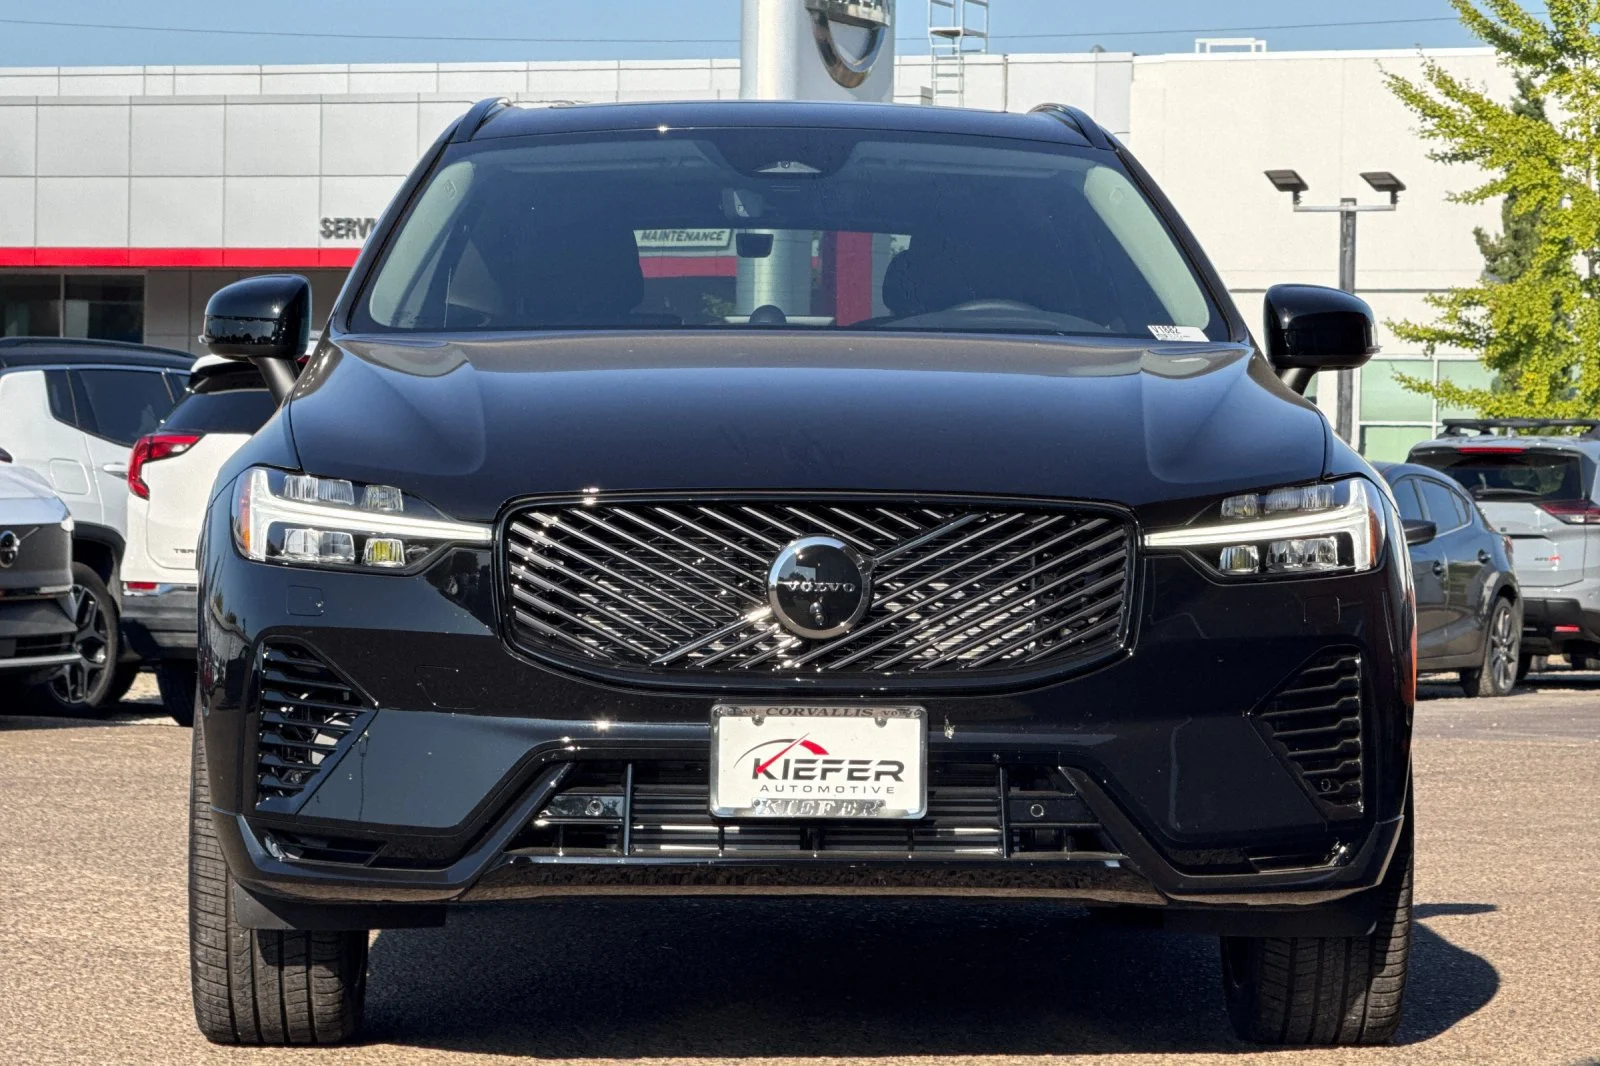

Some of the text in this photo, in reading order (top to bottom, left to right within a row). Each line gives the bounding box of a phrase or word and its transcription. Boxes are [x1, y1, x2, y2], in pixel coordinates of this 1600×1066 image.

[640, 230, 726, 242] MAINTENANCE
[766, 707, 873, 716] CORVALLIS
[752, 757, 905, 782] KIEFER
[760, 784, 895, 794] AUTOMOTIVE
[761, 799, 884, 817] KIEFER
